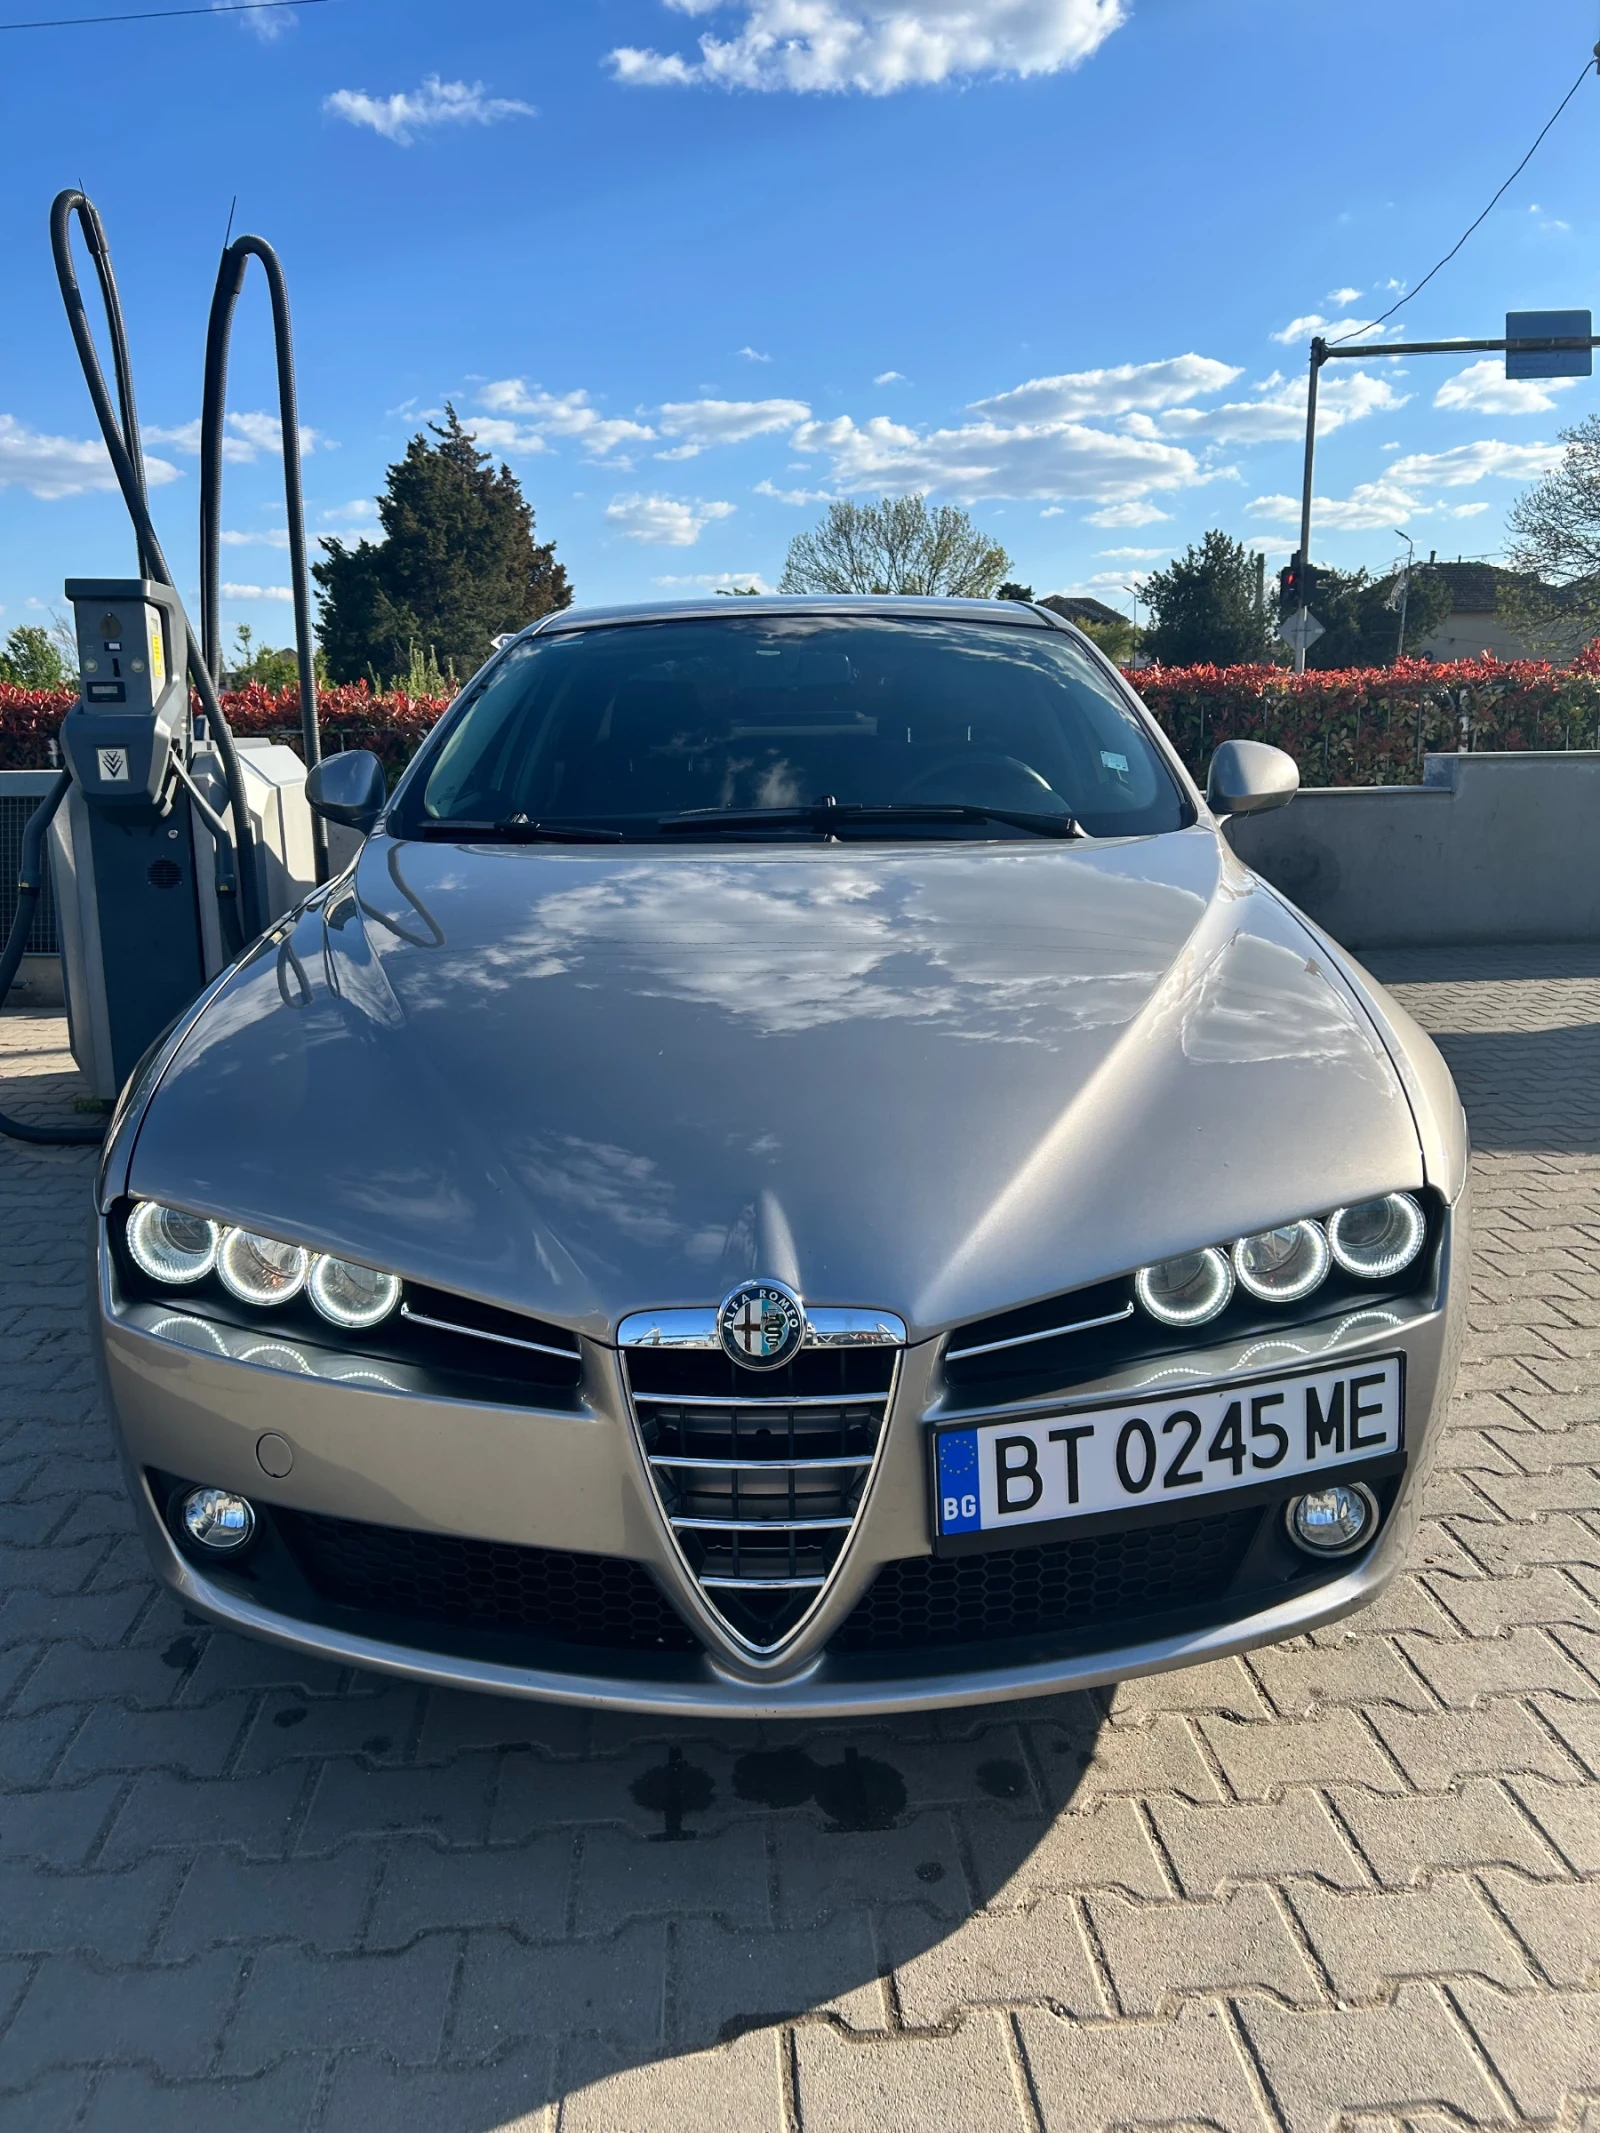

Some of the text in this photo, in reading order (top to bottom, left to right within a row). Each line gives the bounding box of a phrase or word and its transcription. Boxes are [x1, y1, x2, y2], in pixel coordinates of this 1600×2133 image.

[724, 1289, 799, 1330] ALFA ROMEO
[995, 1372, 1388, 1515] BT 0245 ME
[943, 1494, 977, 1521] BG
